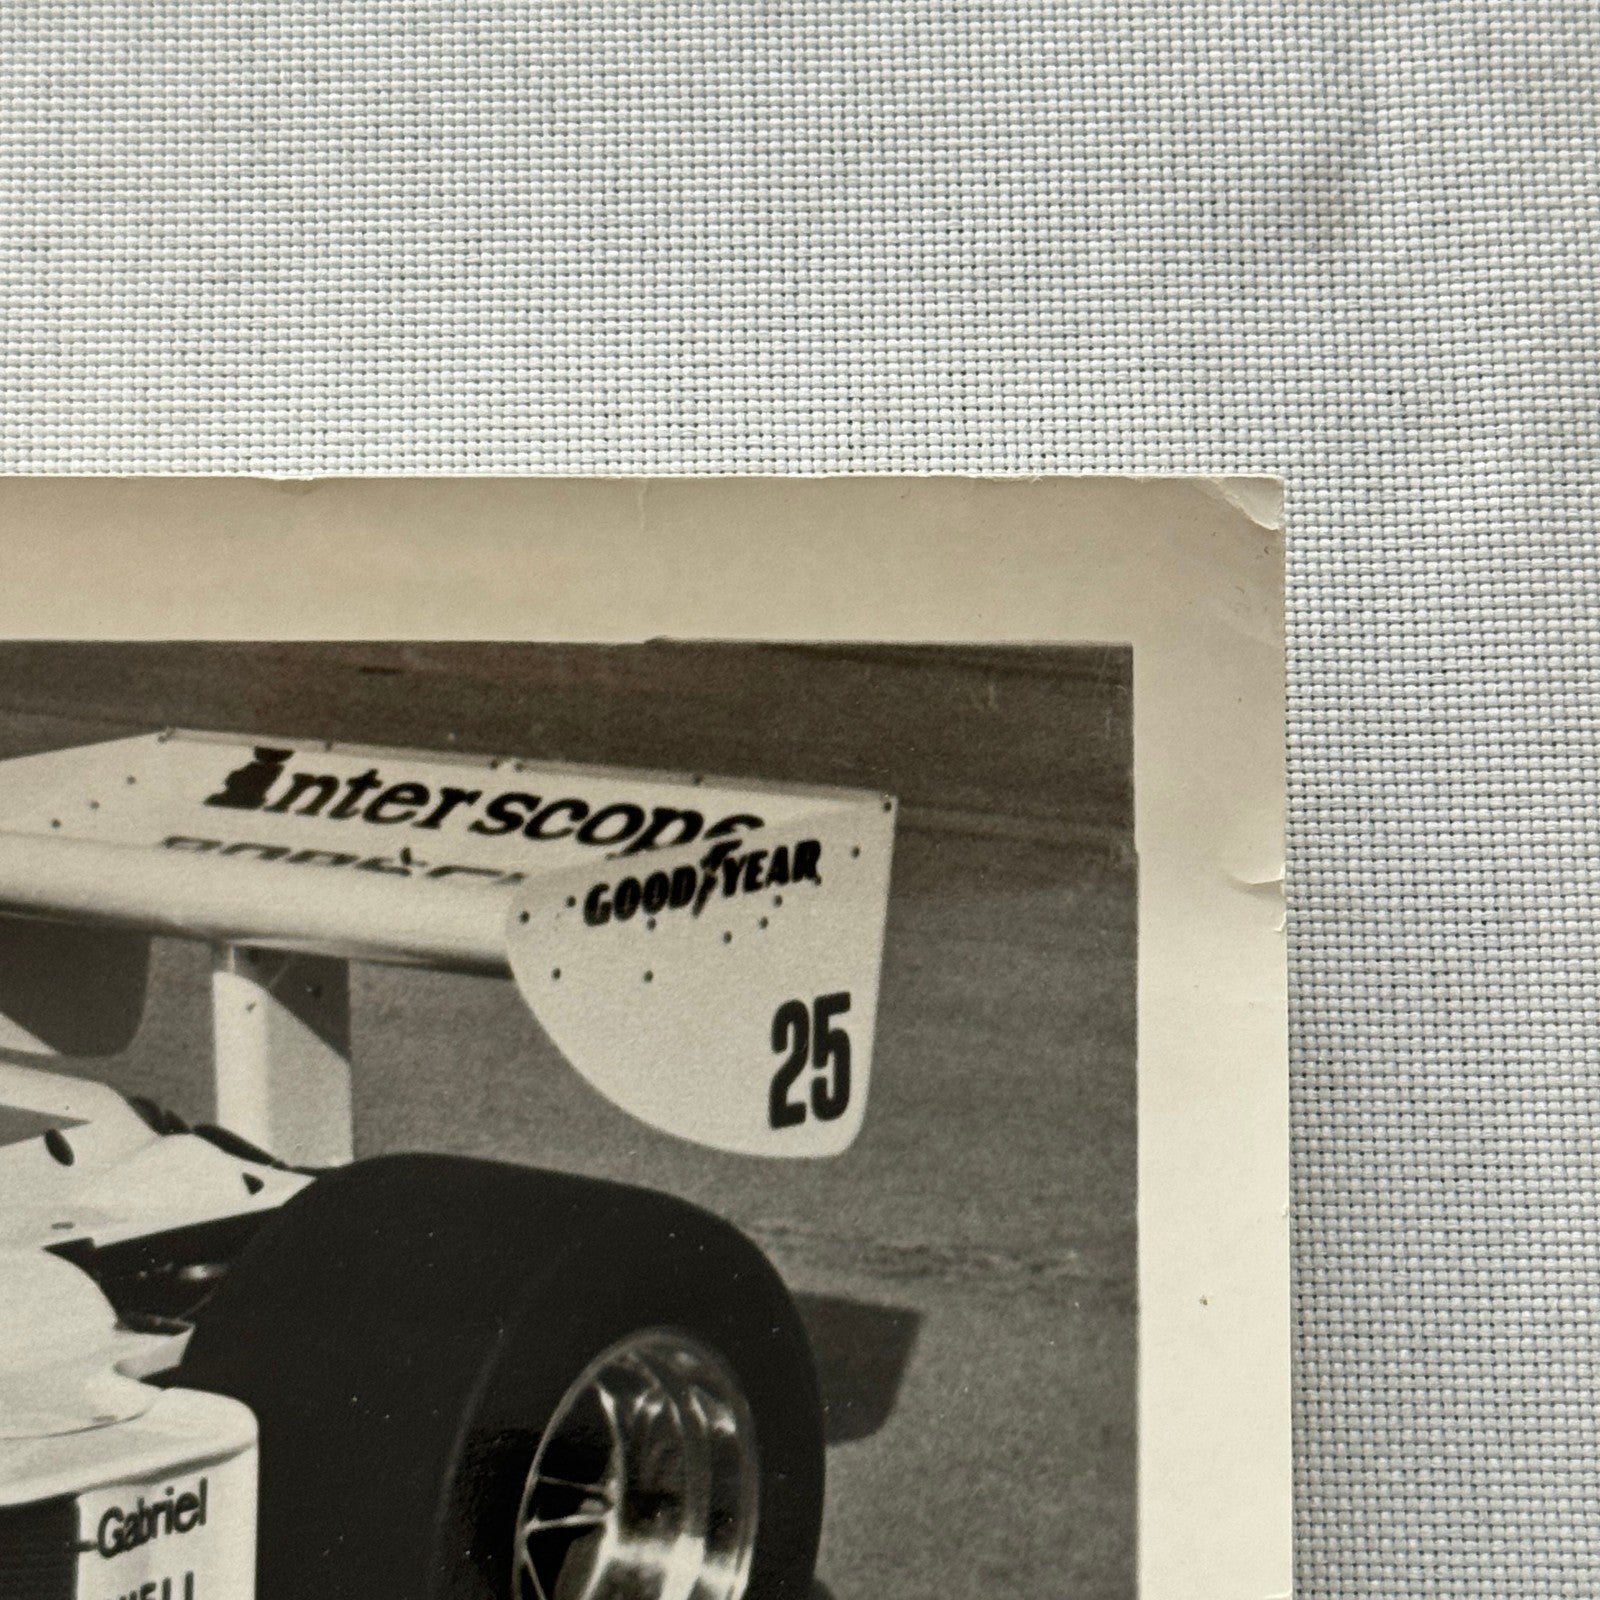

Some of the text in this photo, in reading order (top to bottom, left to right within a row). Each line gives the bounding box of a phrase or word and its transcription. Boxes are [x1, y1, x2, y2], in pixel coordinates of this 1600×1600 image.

[583, 839, 821, 926] GOODYEAR
[769, 991, 851, 1129] 25
[97, 1477, 208, 1558] Gabriel
